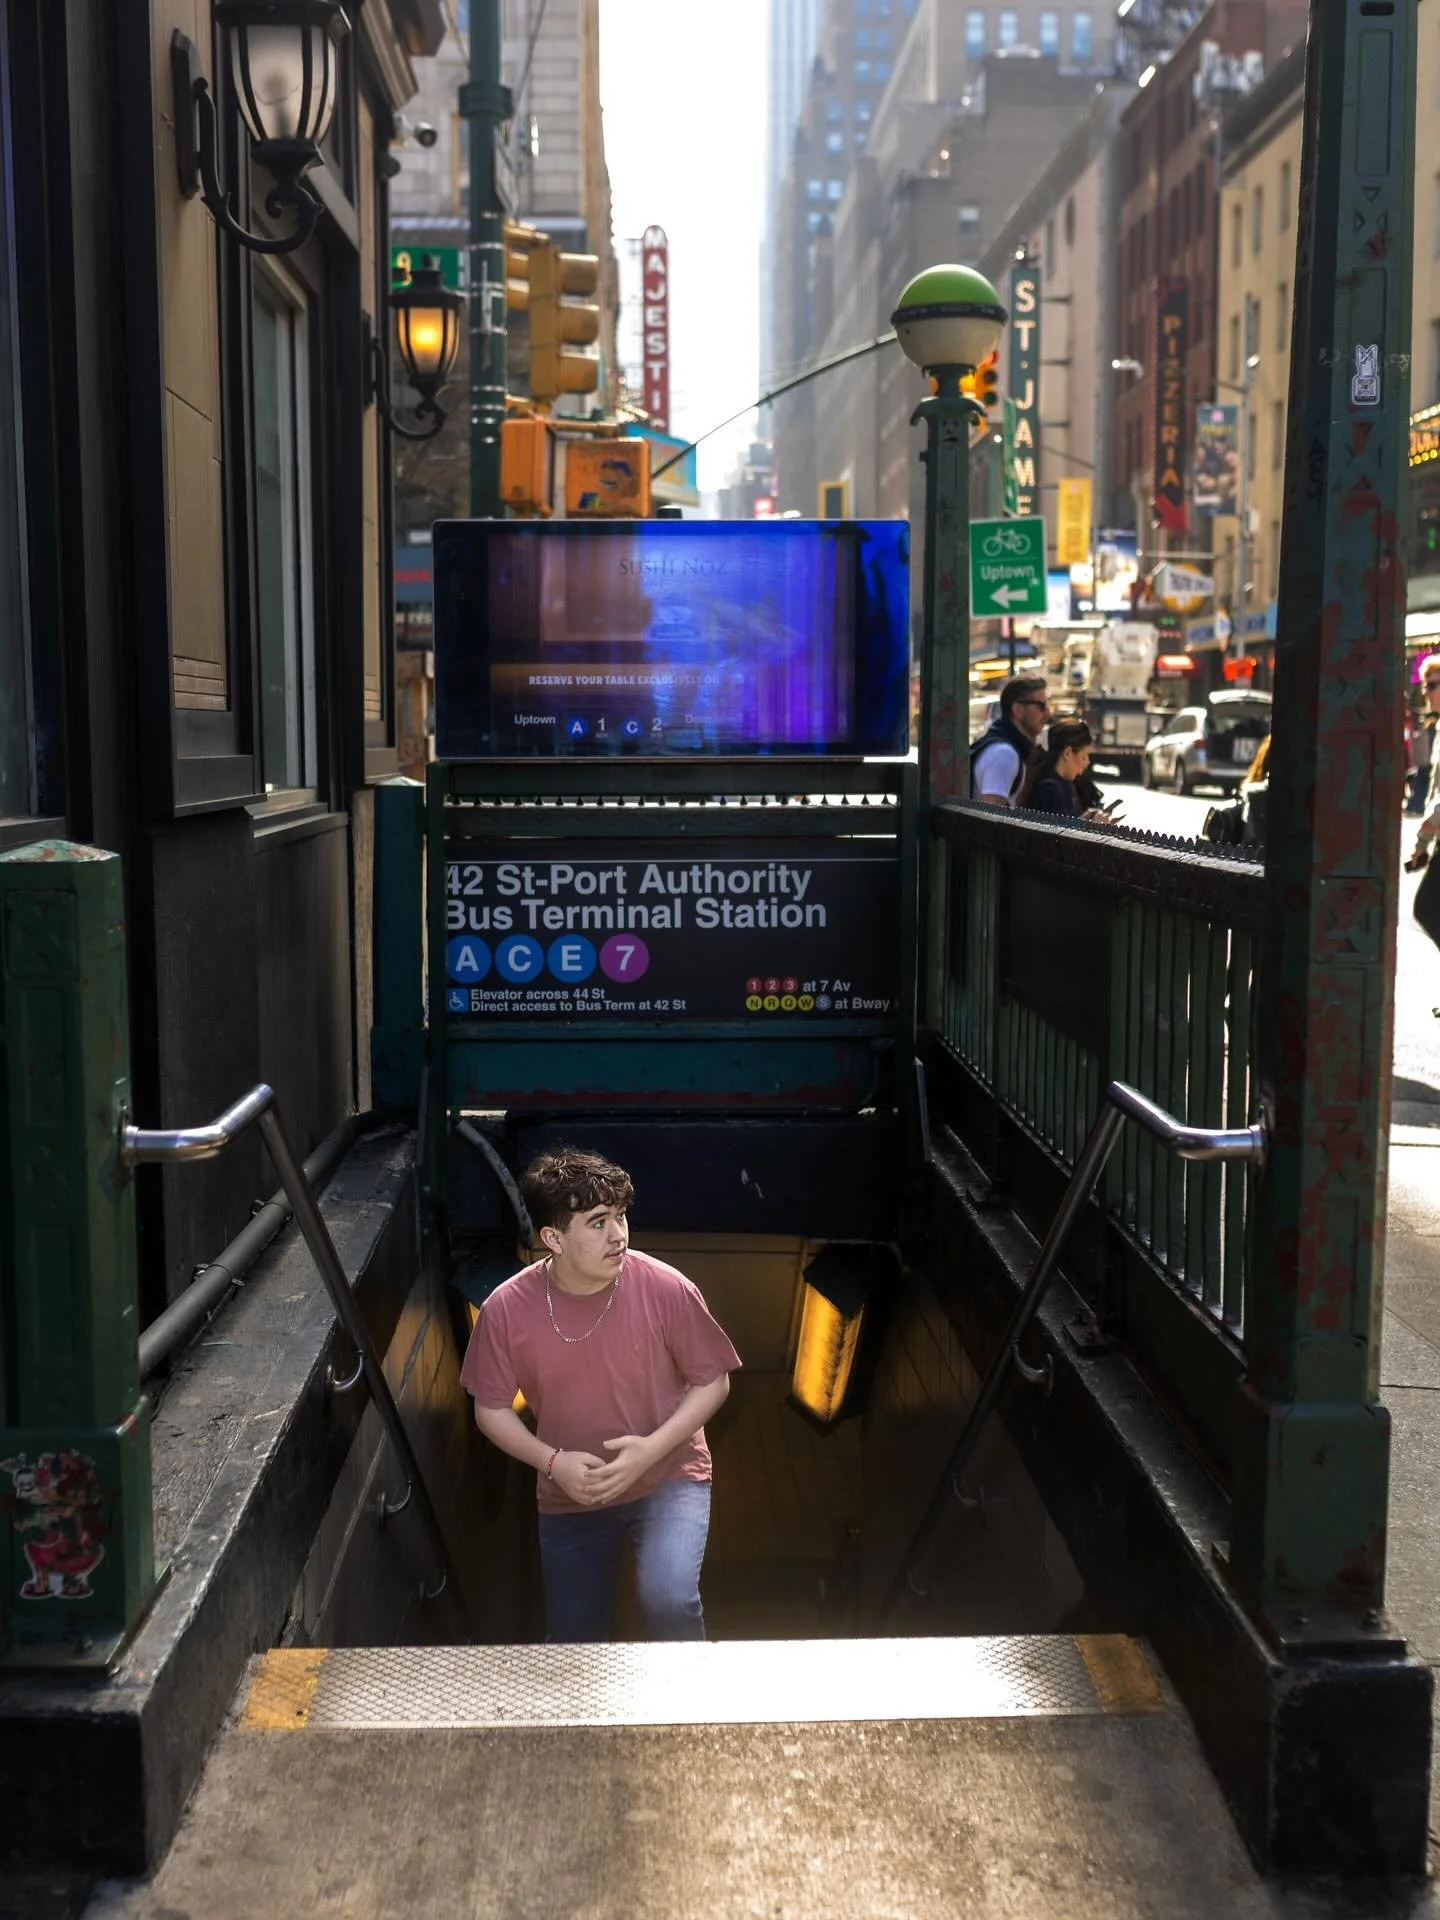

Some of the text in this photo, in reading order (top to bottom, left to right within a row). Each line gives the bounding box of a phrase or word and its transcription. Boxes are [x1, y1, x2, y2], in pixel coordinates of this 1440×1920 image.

[1160, 314, 1183, 487] PIZZERIA
[619, 558, 674, 576] SUSHI
[981, 565, 1035, 583] Uptown
[528, 675, 573, 685] RESERVE
[575, 675, 603, 685] YOUR
[605, 675, 635, 685] TABLE
[514, 714, 663, 733] Uptown A 1 C 2
[447, 863, 812, 901] 42 St-Port Authority
[447, 897, 826, 930] Bus Terminal Station
[455, 945, 635, 972] A C E 7
[471, 988, 605, 1000] Elevator across 44 St
[803, 980, 817, 992] at
[820, 981, 829, 992] 7
[832, 980, 851, 992] Av
[471, 999, 687, 1011] Direct access to Bus Term at 42 St
[835, 999, 848, 1009] at
[852, 998, 890, 1012] Bway
